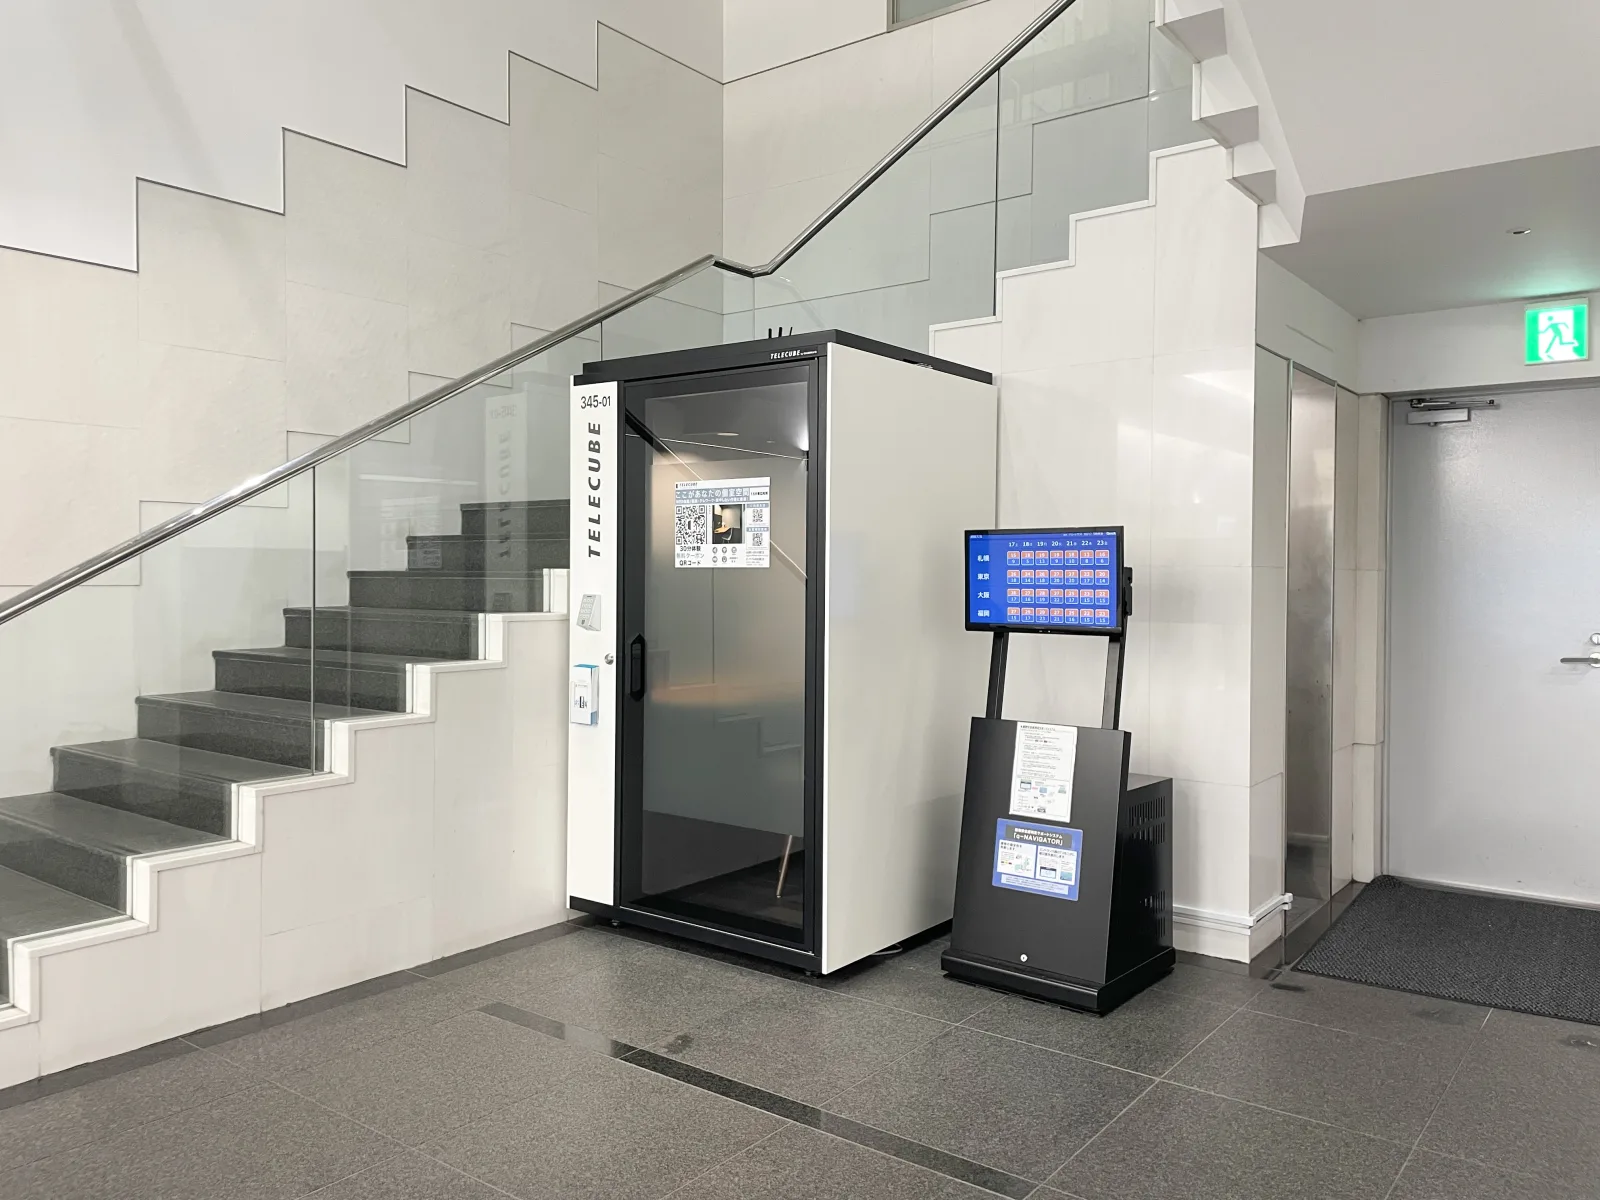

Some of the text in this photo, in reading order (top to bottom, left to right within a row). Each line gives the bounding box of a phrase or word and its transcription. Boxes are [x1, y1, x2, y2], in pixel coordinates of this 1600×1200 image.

[770, 349, 801, 359] TELECUBE
[580, 395, 611, 409] 345-01
[588, 422, 601, 557] TELECUBE
[977, 554, 990, 562] 札幌
[977, 591, 990, 599] 大阪
[977, 609, 990, 617] 福岡
